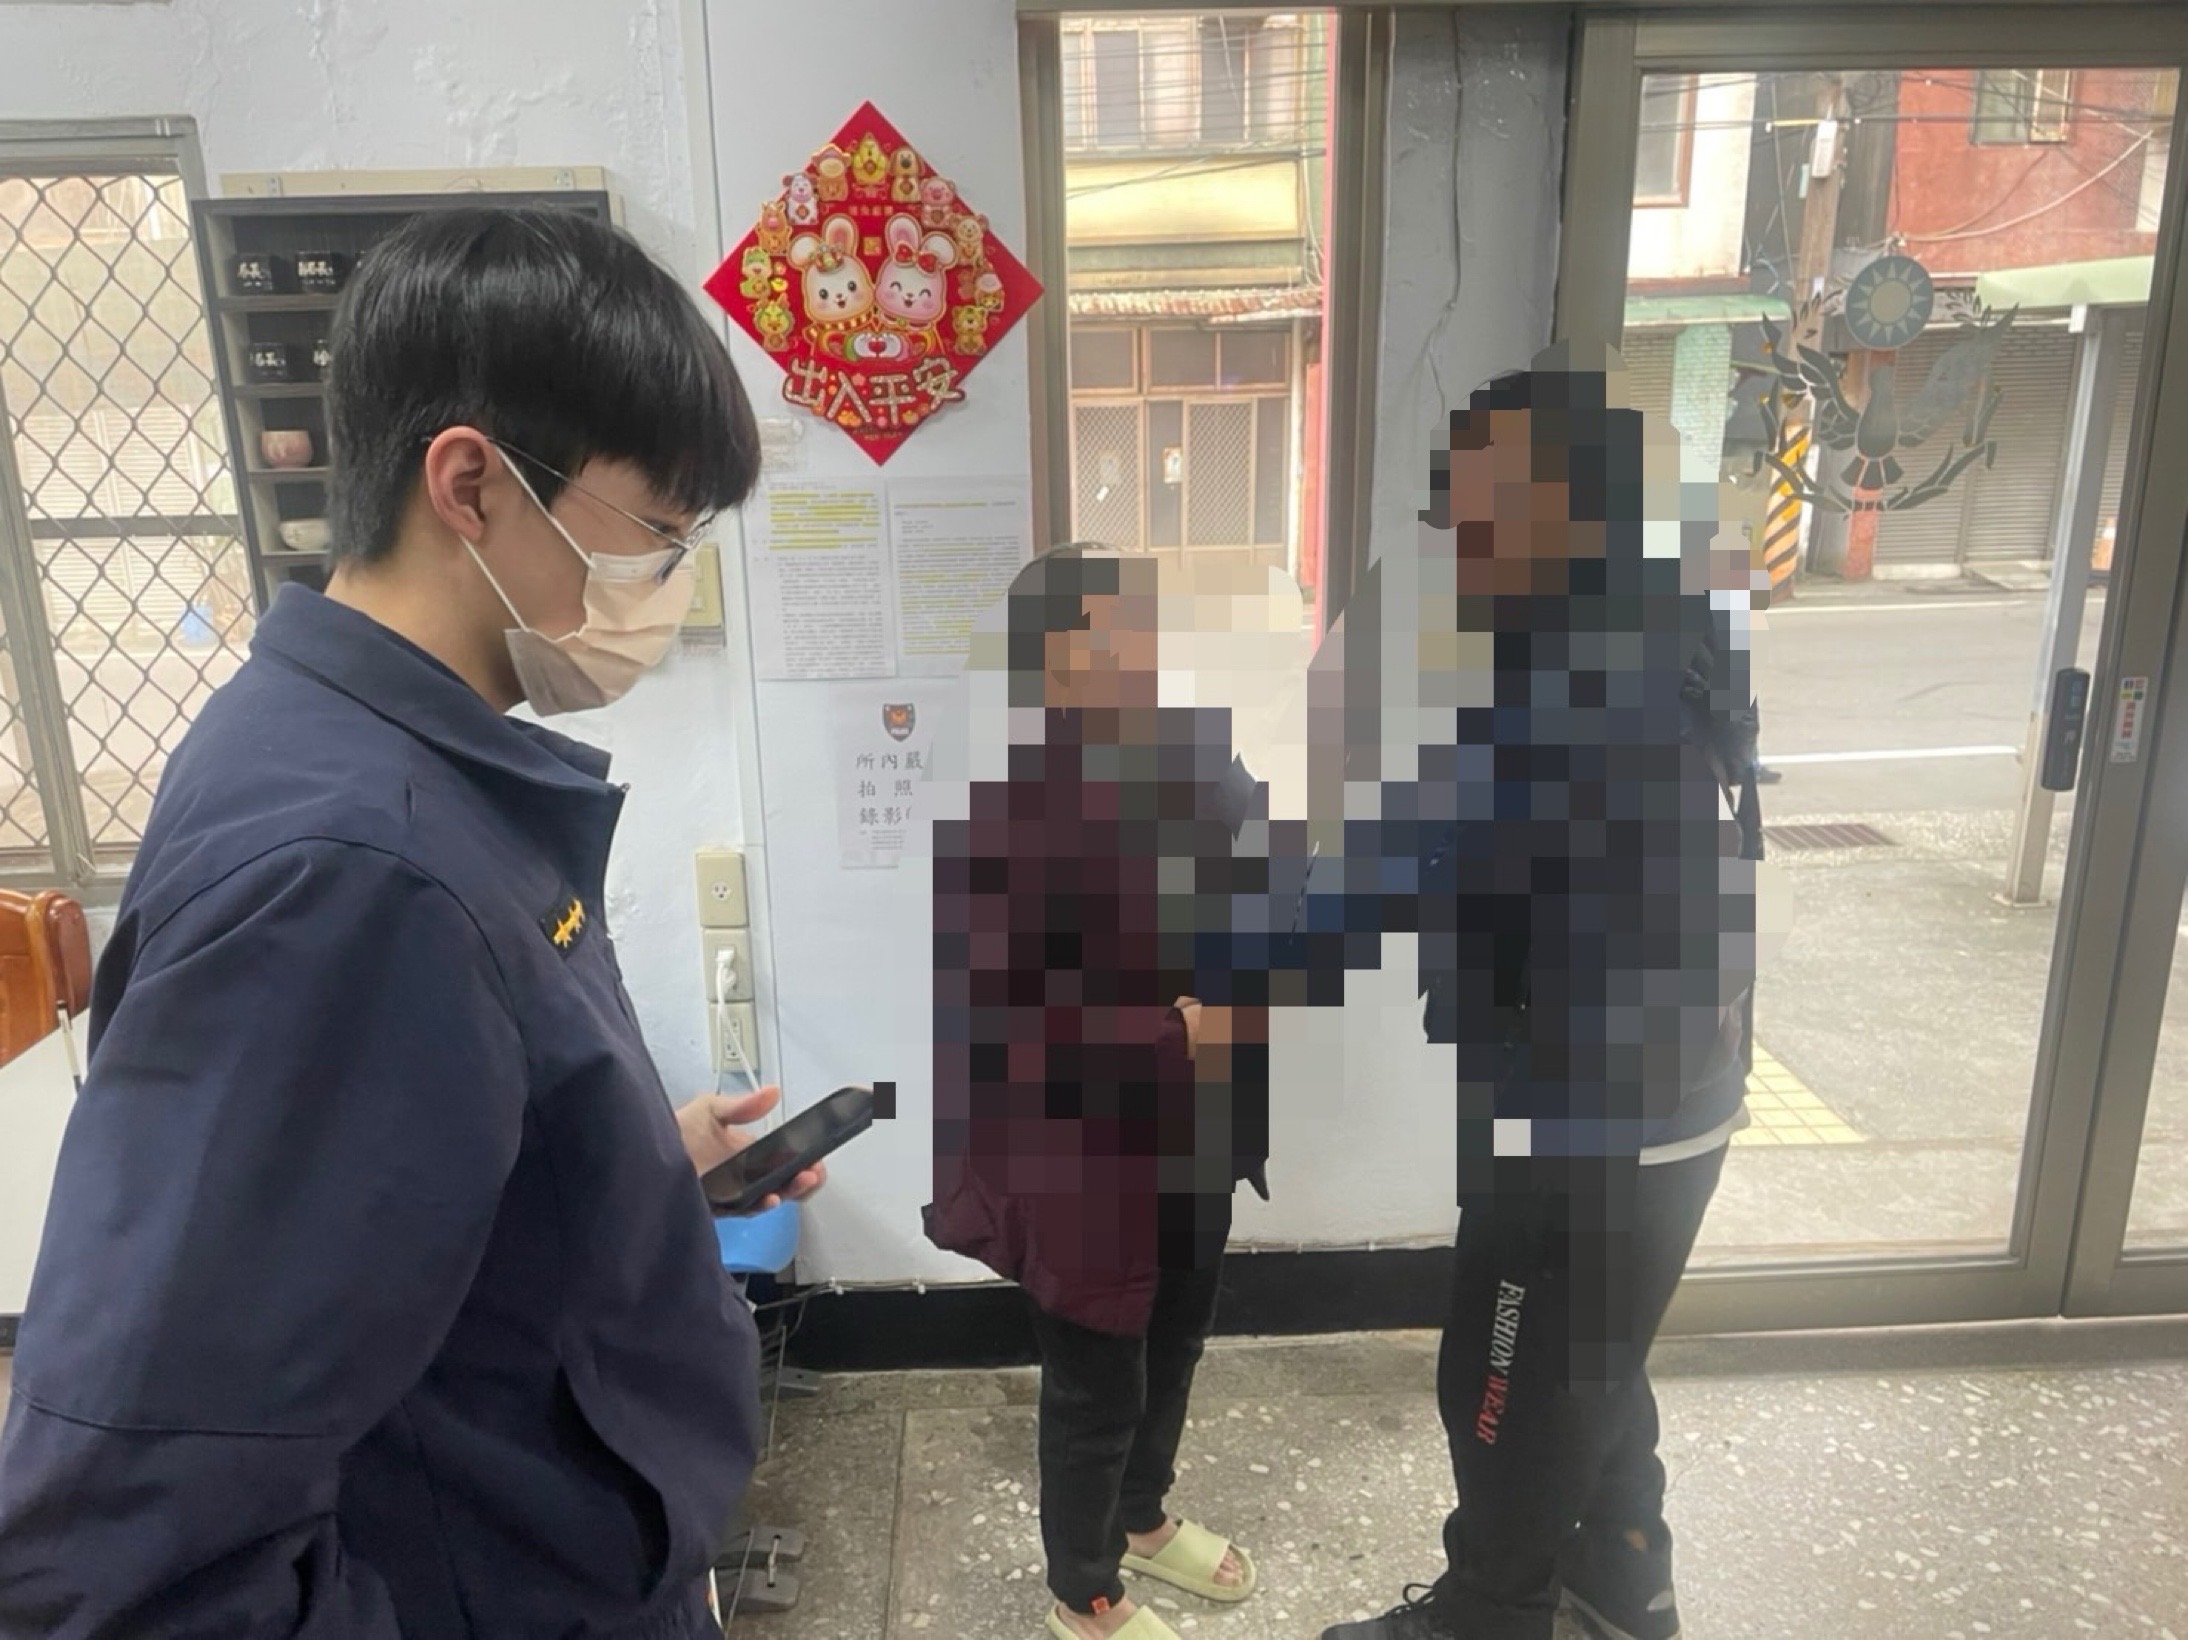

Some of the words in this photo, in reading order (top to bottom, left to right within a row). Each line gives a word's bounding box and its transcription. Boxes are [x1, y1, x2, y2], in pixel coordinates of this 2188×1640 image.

[784, 357, 962, 424] 出入平安
[1490, 1280, 1526, 1375] FASHION
[1477, 1376, 1509, 1444] WEAR
